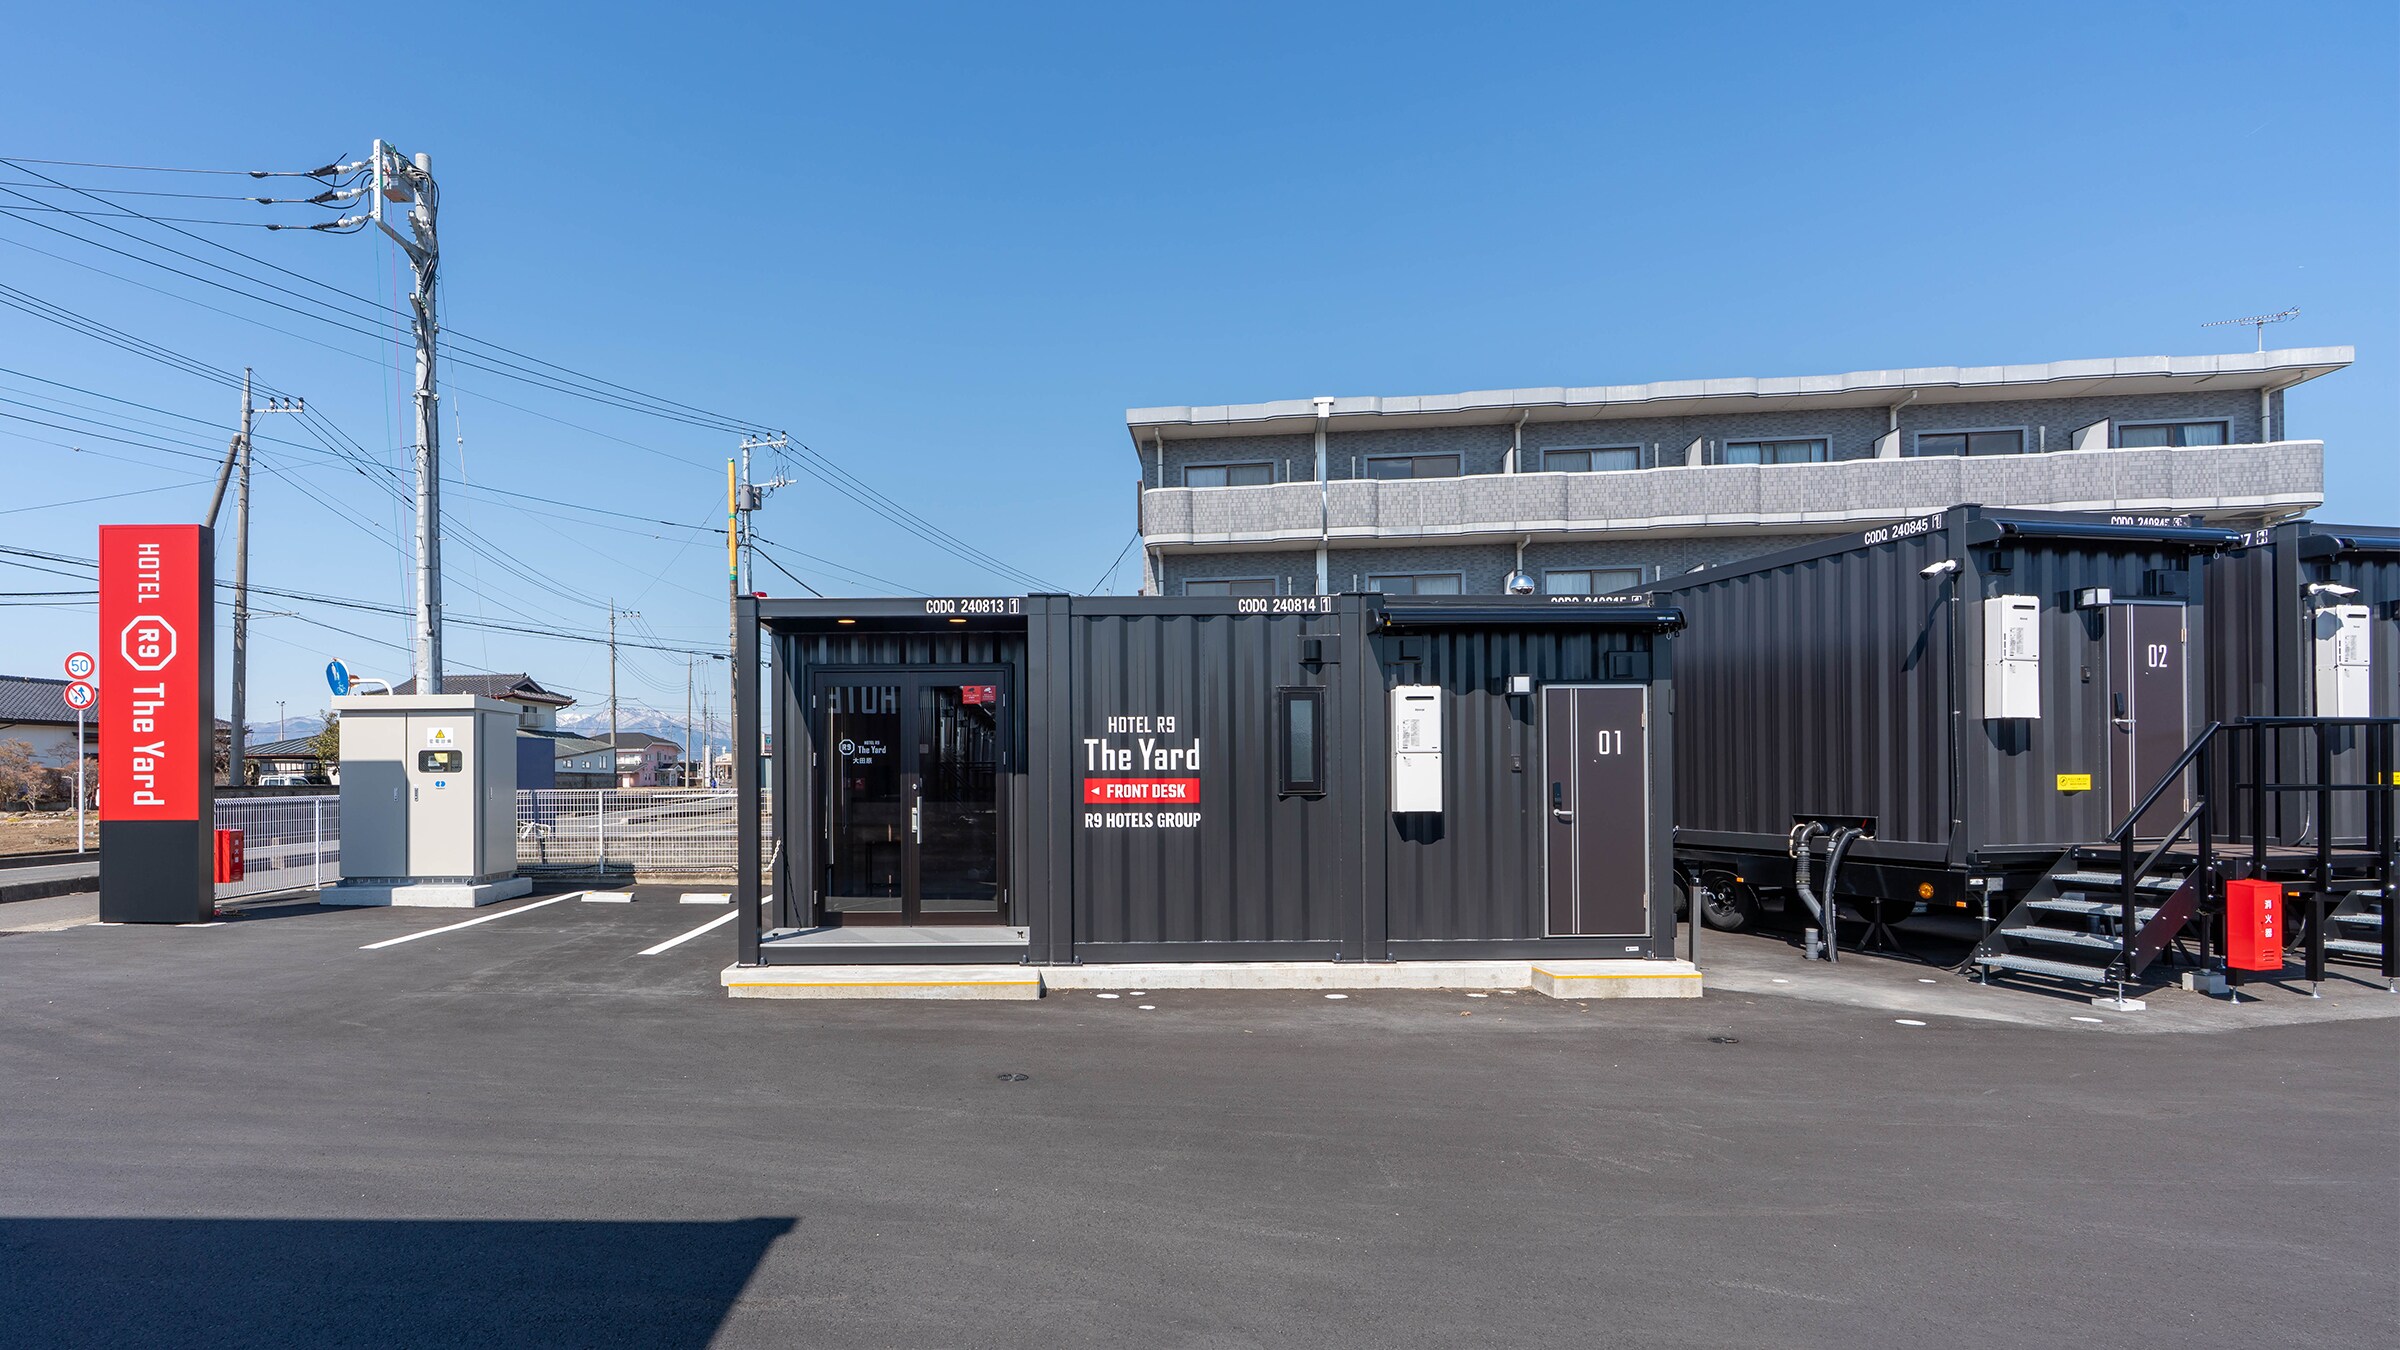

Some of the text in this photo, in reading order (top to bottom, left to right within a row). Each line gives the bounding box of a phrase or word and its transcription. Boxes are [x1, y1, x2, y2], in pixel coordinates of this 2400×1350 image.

[1864, 528, 1888, 545] CODQ
[1892, 518, 1928, 538] 240845
[926, 600, 955, 613] CODQ
[961, 599, 1004, 613] 240813
[1238, 599, 1268, 612] CODQ
[1273, 598, 1316, 612] 240814
[2148, 644, 2168, 668] 02
[71, 659, 89, 672] 50
[132, 543, 165, 806] HOTEL R9 The Yard
[1108, 716, 1175, 733] HOTEL R9
[858, 745, 887, 754] The Yard
[1598, 730, 1622, 755] 01
[1084, 738, 1200, 771] The Yard
[1106, 783, 1187, 799] FRONT DESK
[1084, 812, 1202, 829] R9 HOTELS GROUP
[2264, 899, 2273, 938] 消火器
